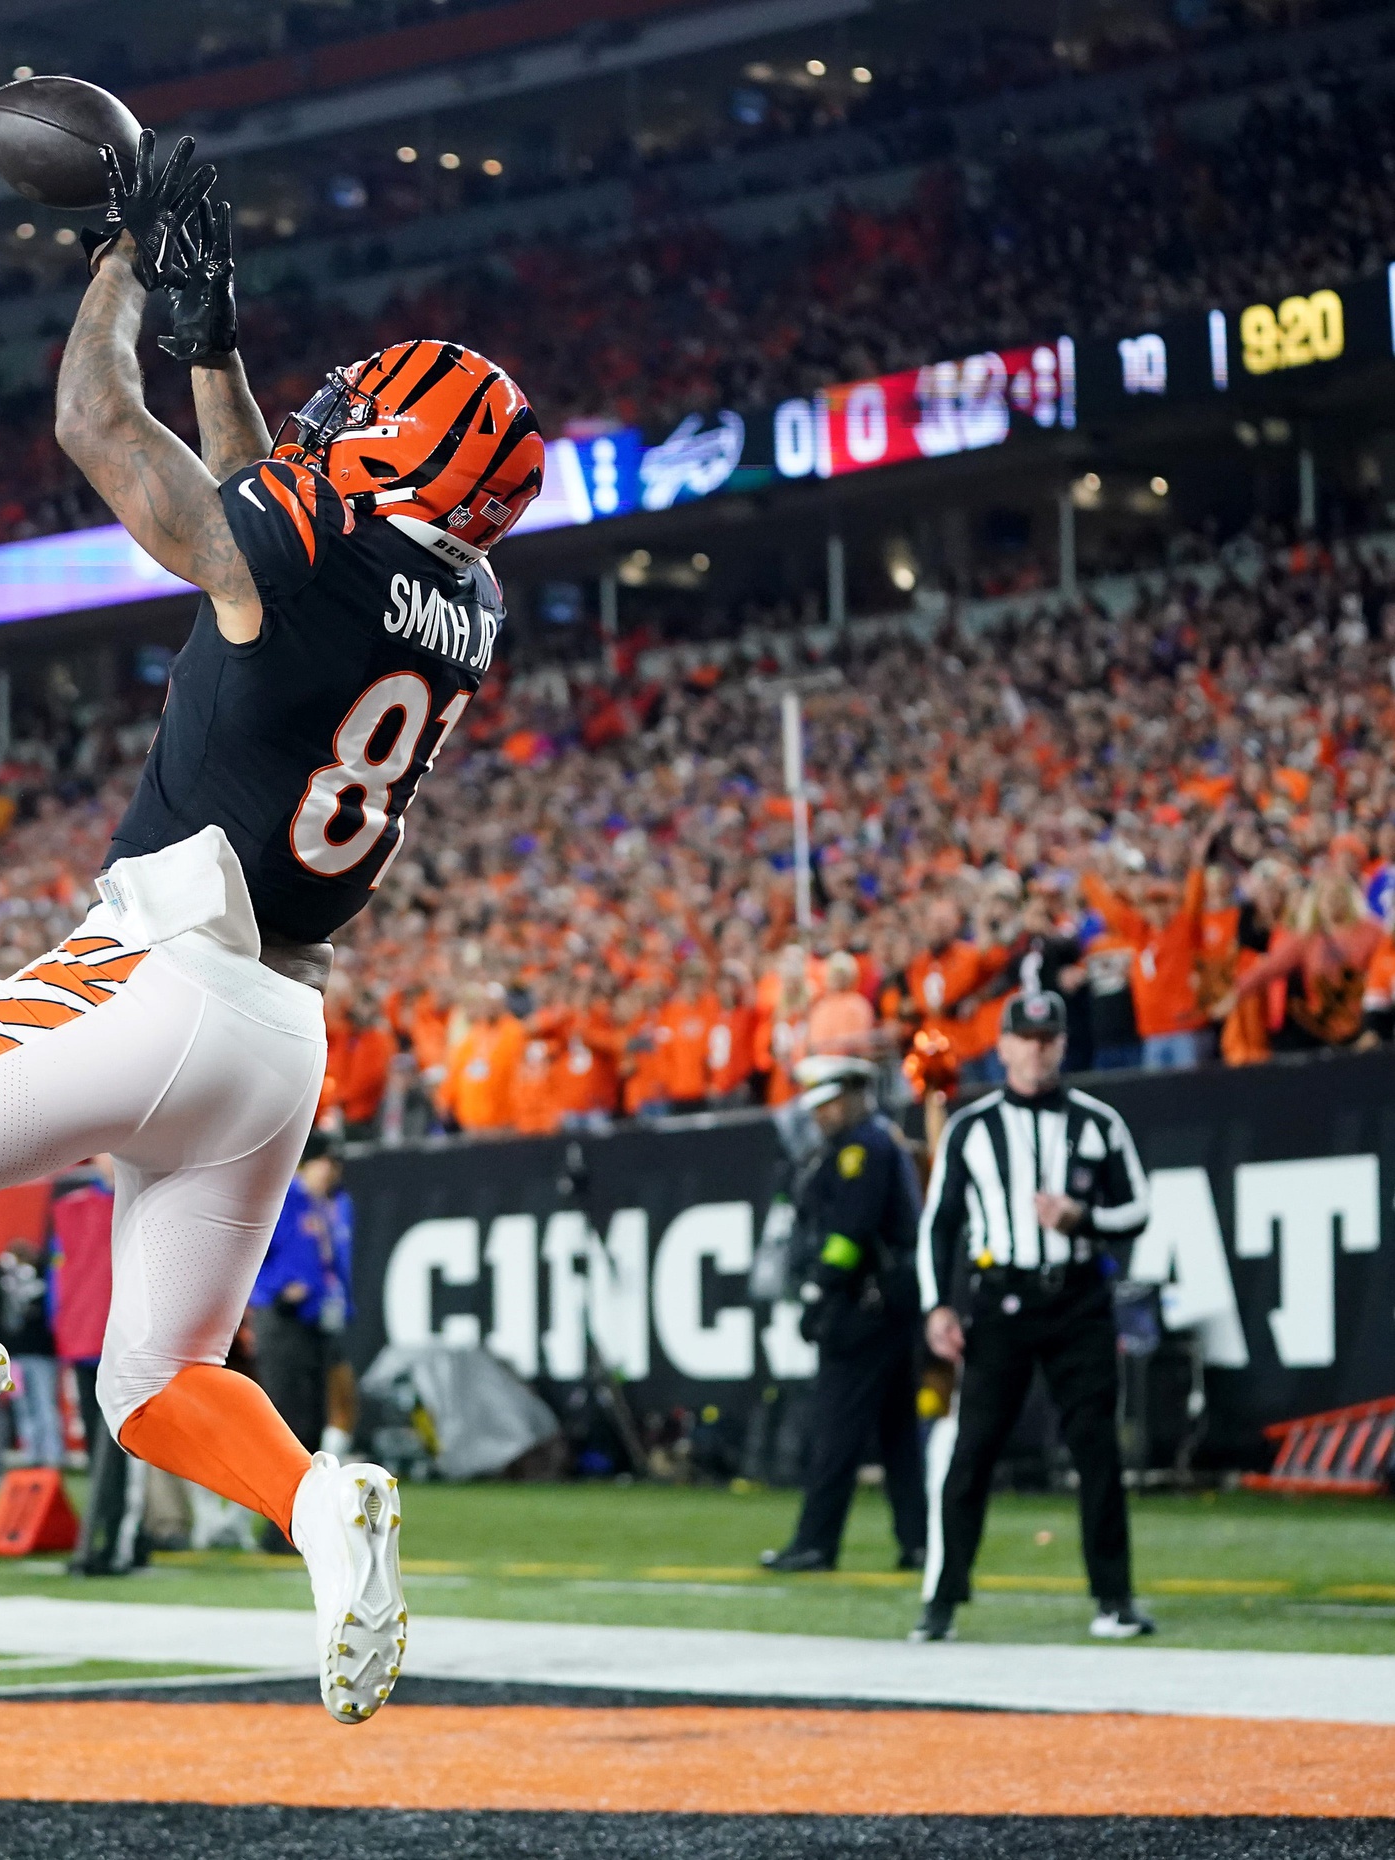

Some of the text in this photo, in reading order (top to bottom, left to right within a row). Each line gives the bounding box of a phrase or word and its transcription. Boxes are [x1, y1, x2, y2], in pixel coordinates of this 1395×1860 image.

[775, 398, 813, 478] 0
[846, 383, 888, 463] 0
[1239, 288, 1345, 375] 9:20
[383, 573, 498, 671] SMITH JR
[289, 670, 474, 890] 81
[112, 881, 128, 913] northwest
